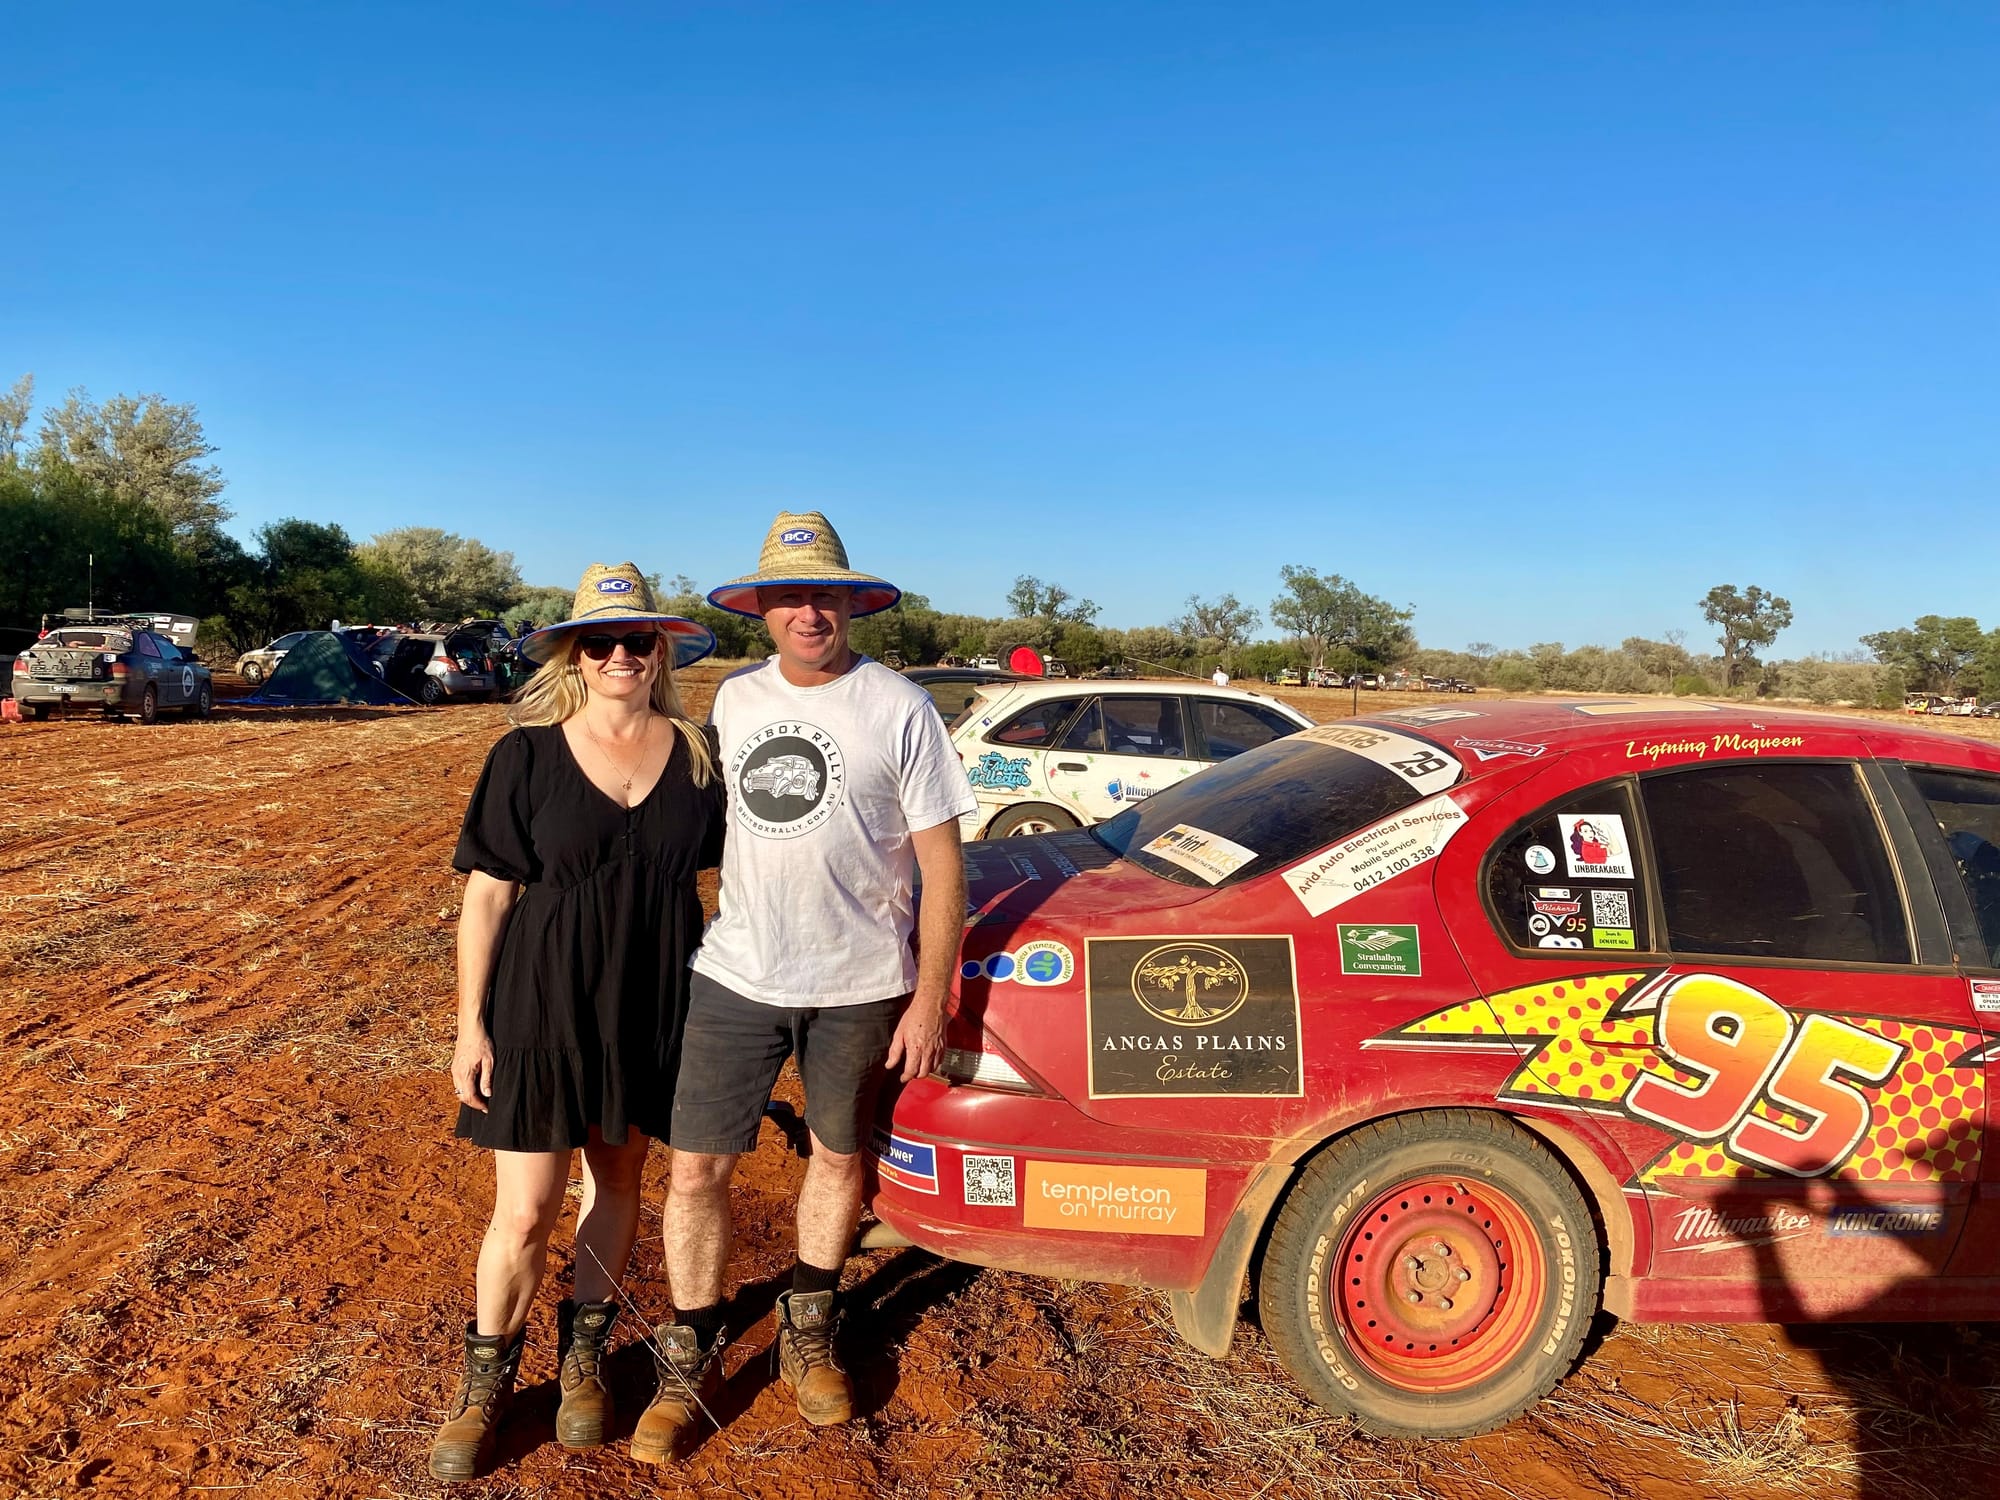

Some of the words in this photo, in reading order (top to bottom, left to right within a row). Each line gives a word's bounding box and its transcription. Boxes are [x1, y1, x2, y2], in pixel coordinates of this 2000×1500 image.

[784, 532, 812, 541] BCF
[600, 581, 630, 590] BCF
[732, 725, 802, 772] SHITBOX
[812, 732, 842, 784] RALLY
[1625, 739, 1709, 761] Ligtning
[1711, 734, 1804, 755] Mcqueen
[1389, 750, 1449, 778] 29
[1298, 872, 1320, 895] Arid
[1318, 852, 1345, 874] Auto
[1343, 822, 1401, 854] Electrical
[1402, 811, 1461, 828] Services
[1350, 854, 1383, 874] Mobile
[1383, 837, 1417, 858] Service
[1365, 843, 1378, 854] Pty
[1377, 840, 1389, 850] Ltd
[1353, 870, 1386, 891] 0412
[1387, 857, 1410, 875] 100
[1411, 845, 1436, 863] 338
[1574, 864, 1627, 875] UNBREAKABLE
[1537, 902, 1577, 912] Stickers
[1566, 917, 1587, 933] 95
[1027, 941, 1057, 952] Fitness
[1062, 953, 1072, 980] Health
[1353, 962, 1407, 972] Conveyancing
[1357, 953, 1402, 963] Strathalbyn
[1102, 1035, 1184, 1051] ANGAS
[1196, 1035, 1287, 1051] PLAINS
[1155, 1054, 1233, 1086] Estate
[1623, 972, 1910, 1177] 95
[1041, 1179, 1171, 1208] templeton
[1332, 1179, 1369, 1226] A/T
[1060, 1202, 1088, 1217] on
[1098, 1204, 1177, 1225] murray
[1673, 1206, 1811, 1242] Milwaukee
[1834, 1212, 1942, 1232] KINCROME
[1542, 1214, 1576, 1357] YOKOHAMA
[1307, 1234, 1360, 1391] GEOLANDAR
